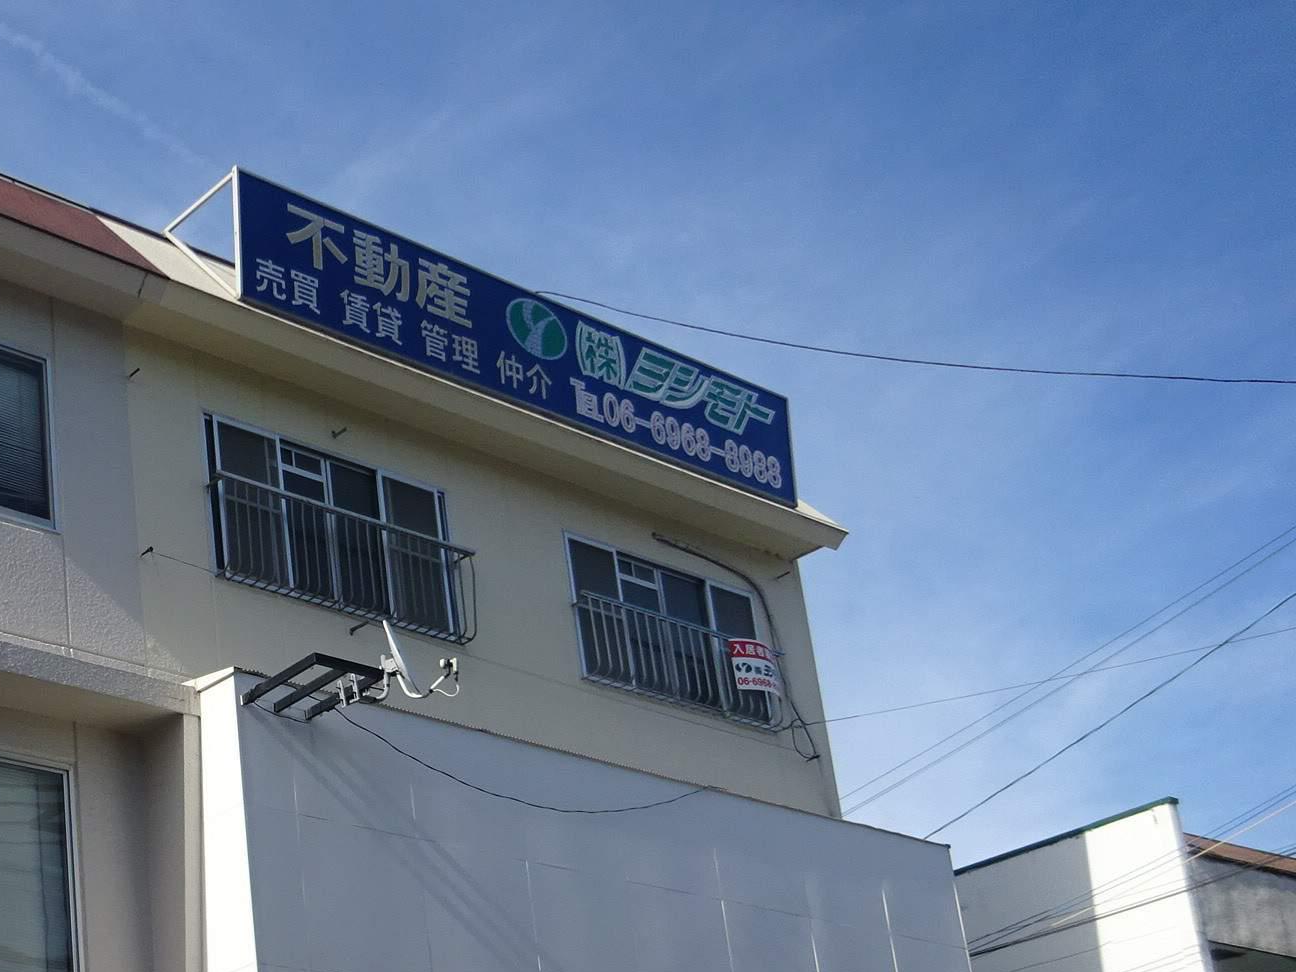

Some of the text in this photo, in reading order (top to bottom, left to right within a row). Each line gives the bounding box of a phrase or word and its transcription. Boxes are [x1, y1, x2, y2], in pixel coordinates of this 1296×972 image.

[286, 203, 472, 328] 不動産
[256, 258, 552, 400] 売買 賃貸 管理 仲介
[733, 644, 770, 658] 入居者
